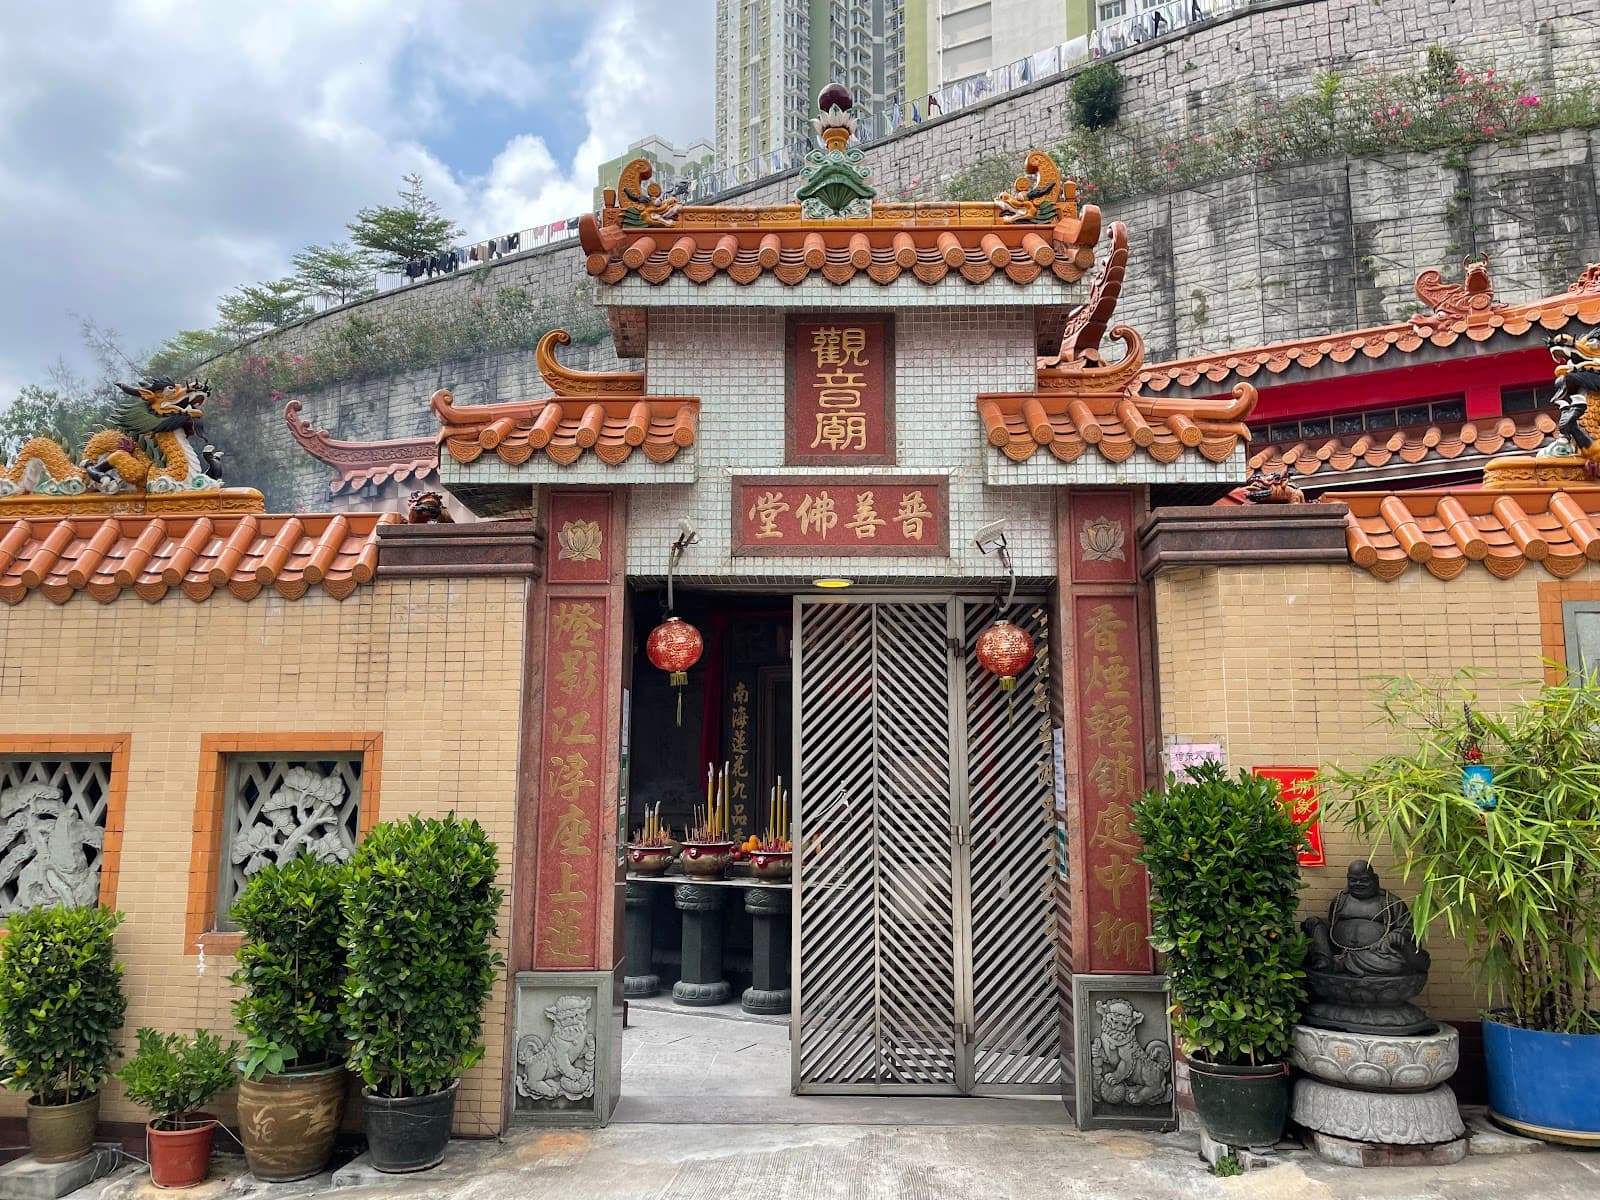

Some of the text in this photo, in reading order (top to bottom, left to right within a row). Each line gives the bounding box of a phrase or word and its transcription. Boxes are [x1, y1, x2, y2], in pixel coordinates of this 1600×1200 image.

[810, 326, 870, 451] 觀音廟
[749, 490, 932, 541] 普善佛堂
